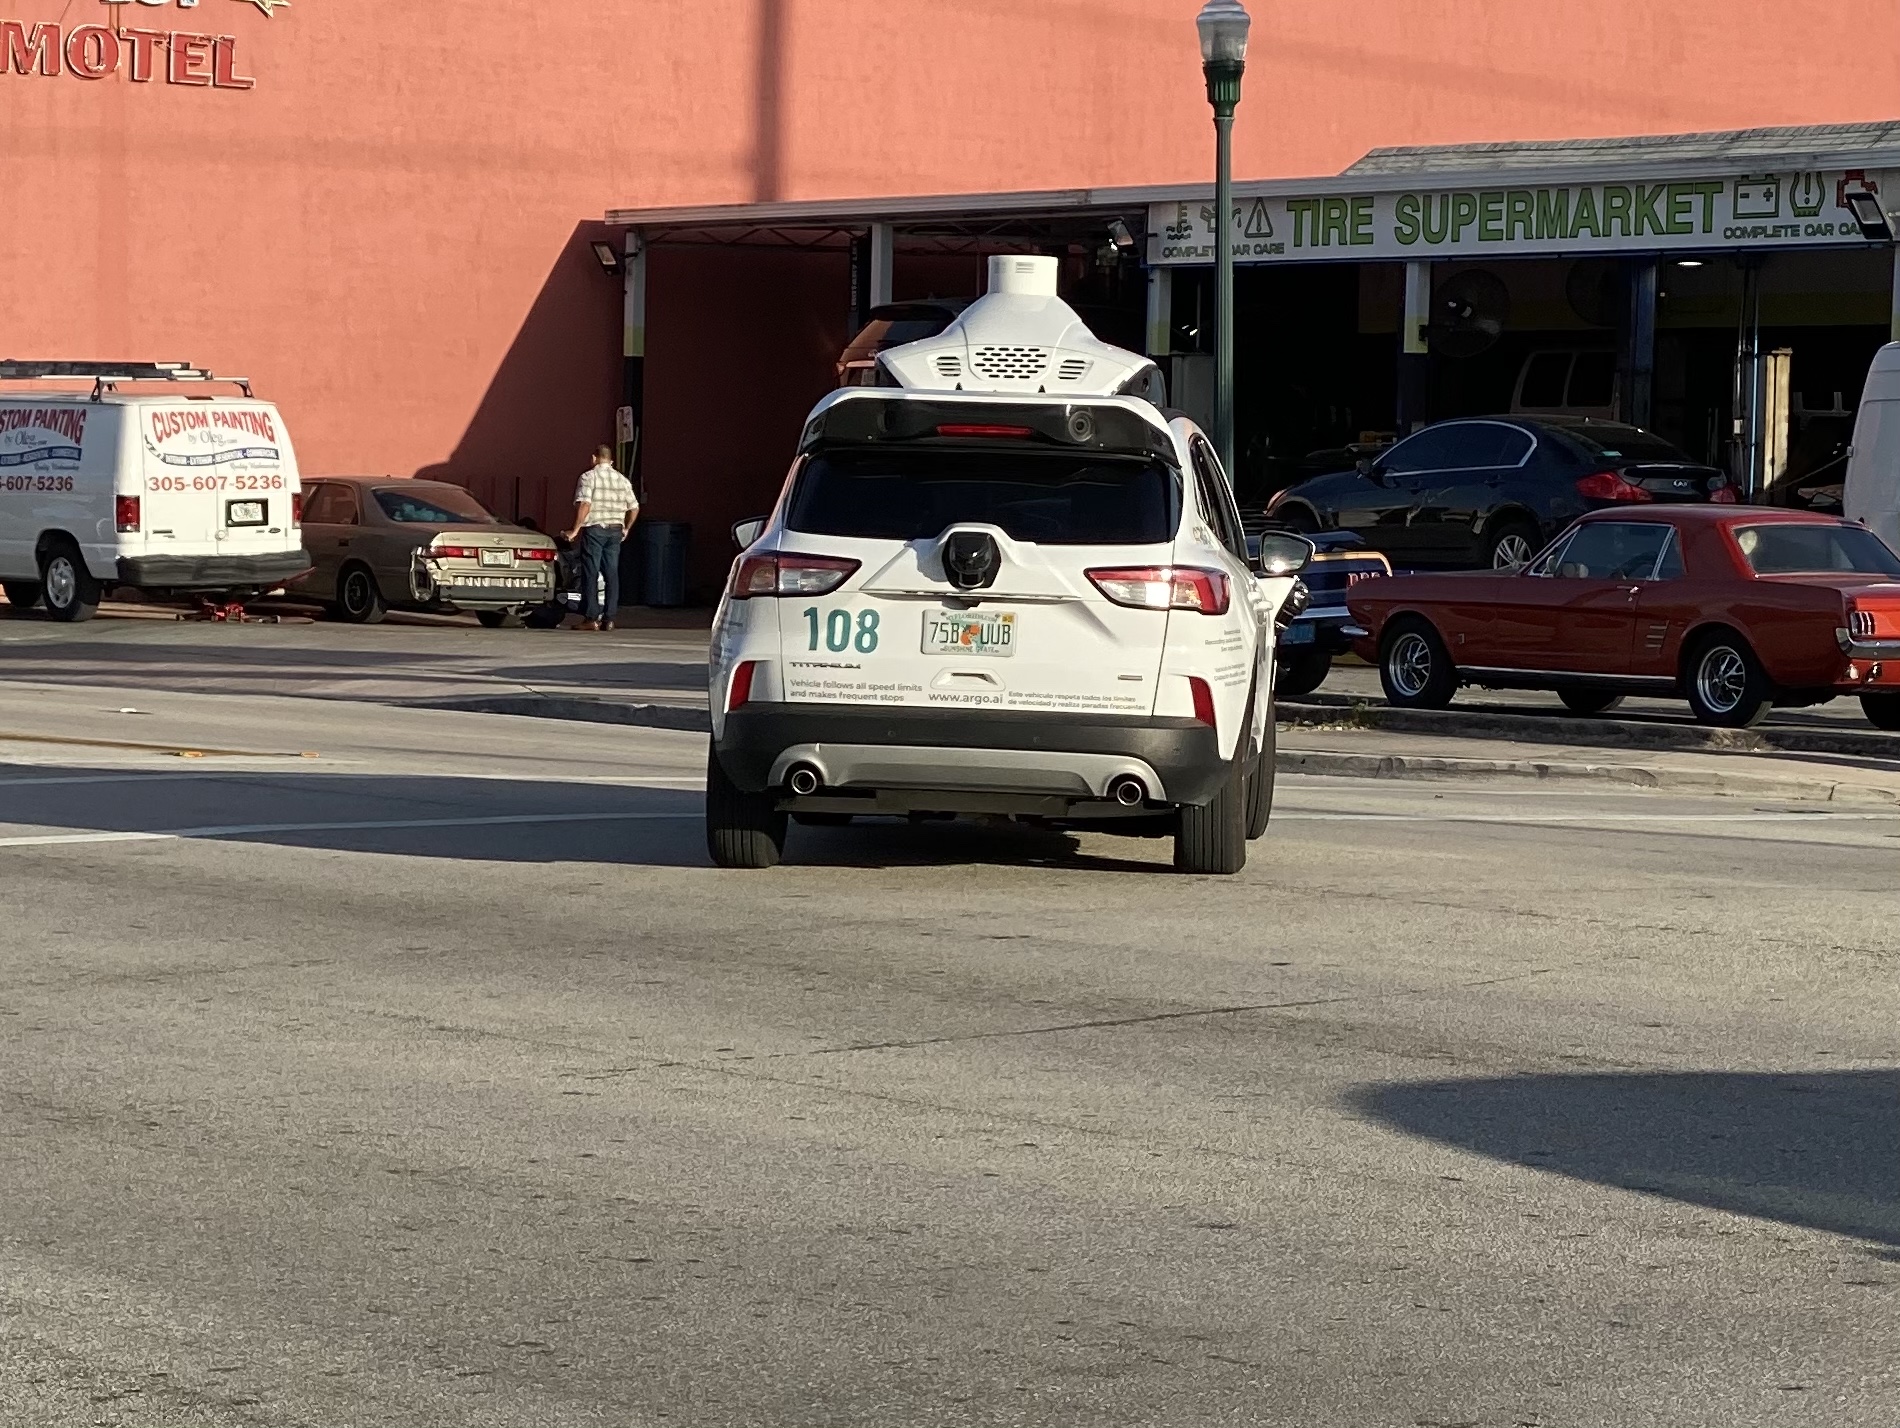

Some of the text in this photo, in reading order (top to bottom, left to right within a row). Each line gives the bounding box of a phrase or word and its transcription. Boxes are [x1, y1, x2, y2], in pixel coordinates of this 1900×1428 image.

[0, 20, 256, 89] MOTEL
[1287, 181, 1724, 247] TIRE SUPERMARKET
[1723, 222, 1863, 240] COMPLETE CAR CA
[1162, 245, 1216, 258] COMPLET
[1253, 242, 1285, 255] CARE
[32, 409, 87, 446] PAINTING
[152, 411, 276, 444] CUSTOM PAINTING
[149, 475, 283, 491] 305-607-5236
[803, 606, 880, 654] 108
[929, 621, 1011, 645] 75B UUB
[790, 679, 923, 692] Vehicle follows all speed limits
[790, 689, 905, 702] and makes frequent stops
[928, 693, 1003, 705] www.argo.ai
[1018, 699, 1051, 708] velocidad
[1081, 702, 1108, 710] paradas
